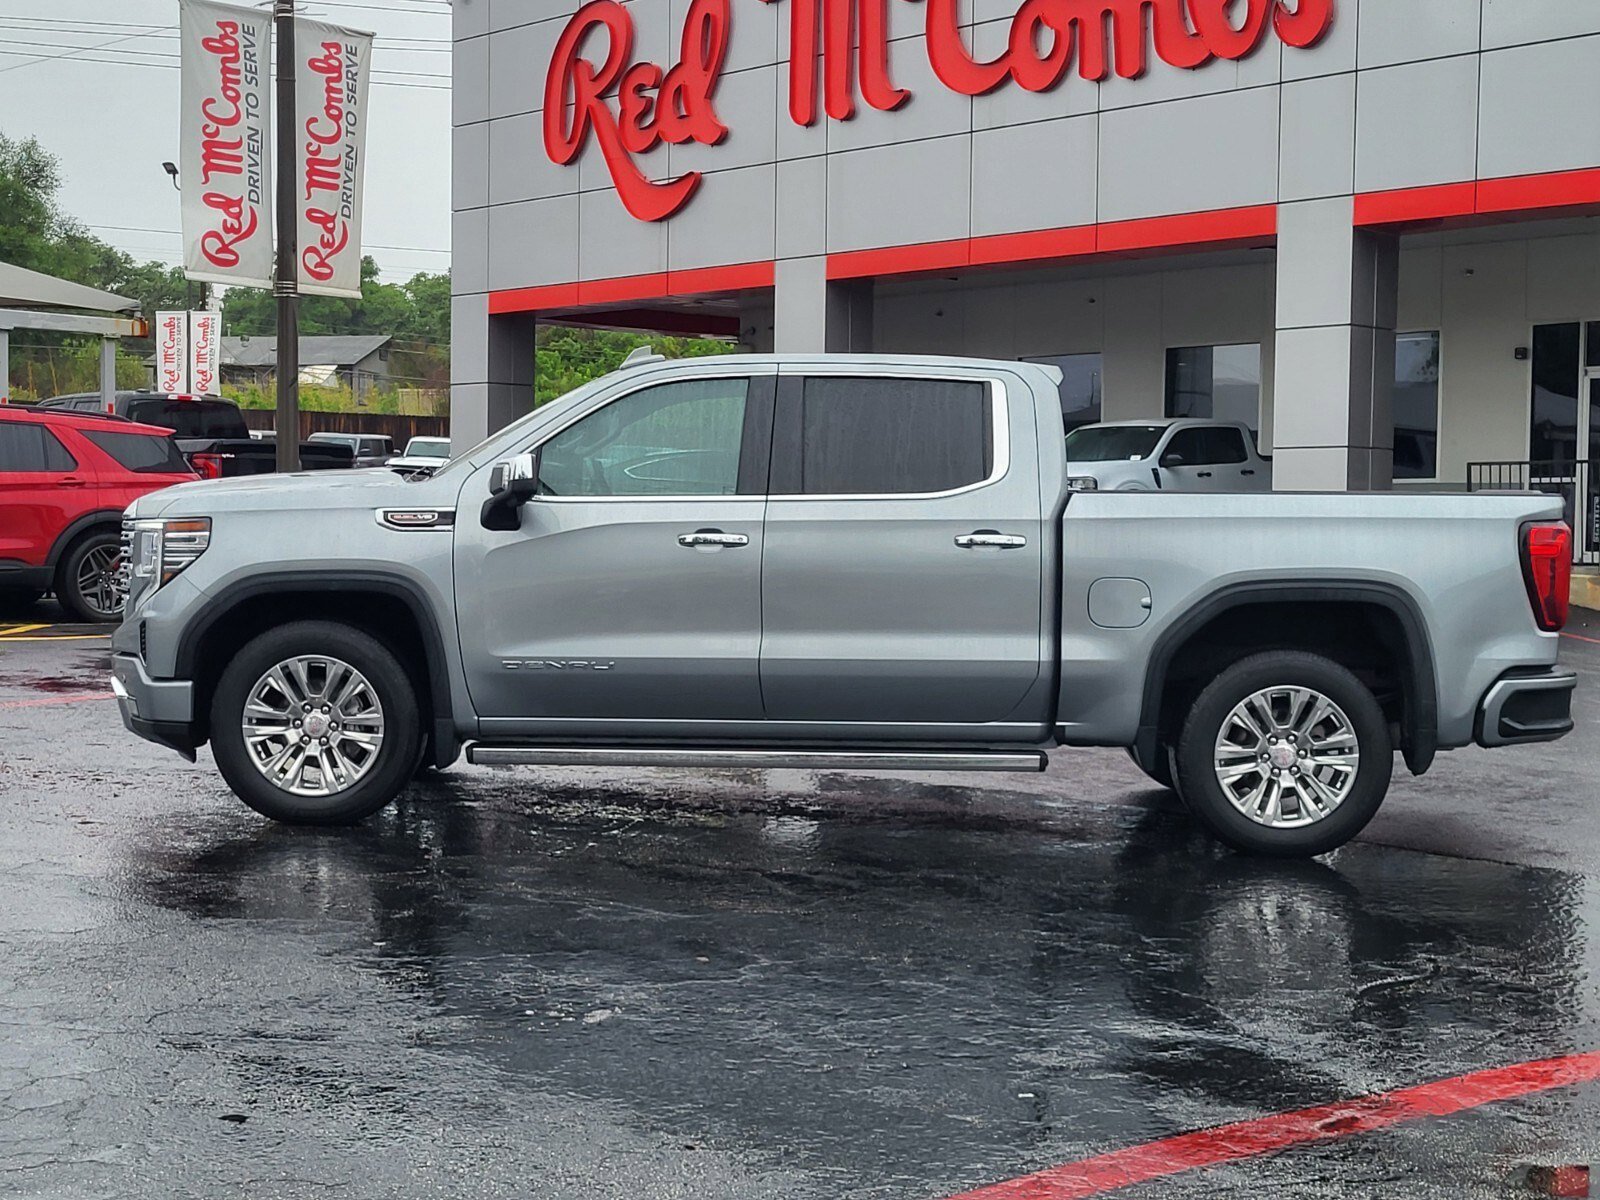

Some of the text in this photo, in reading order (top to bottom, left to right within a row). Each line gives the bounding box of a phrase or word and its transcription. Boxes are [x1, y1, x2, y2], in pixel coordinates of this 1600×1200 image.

[201, 20, 257, 268] Red McCombs
[242, 23, 260, 205] DRIVEN TO SERVE
[302, 41, 348, 281] Red McCombs
[341, 43, 359, 220] DRIVEN TO SERVE
[543, 0, 1333, 222] Red MCom
[163, 369, 181, 392] Red
[195, 369, 213, 392] Red
